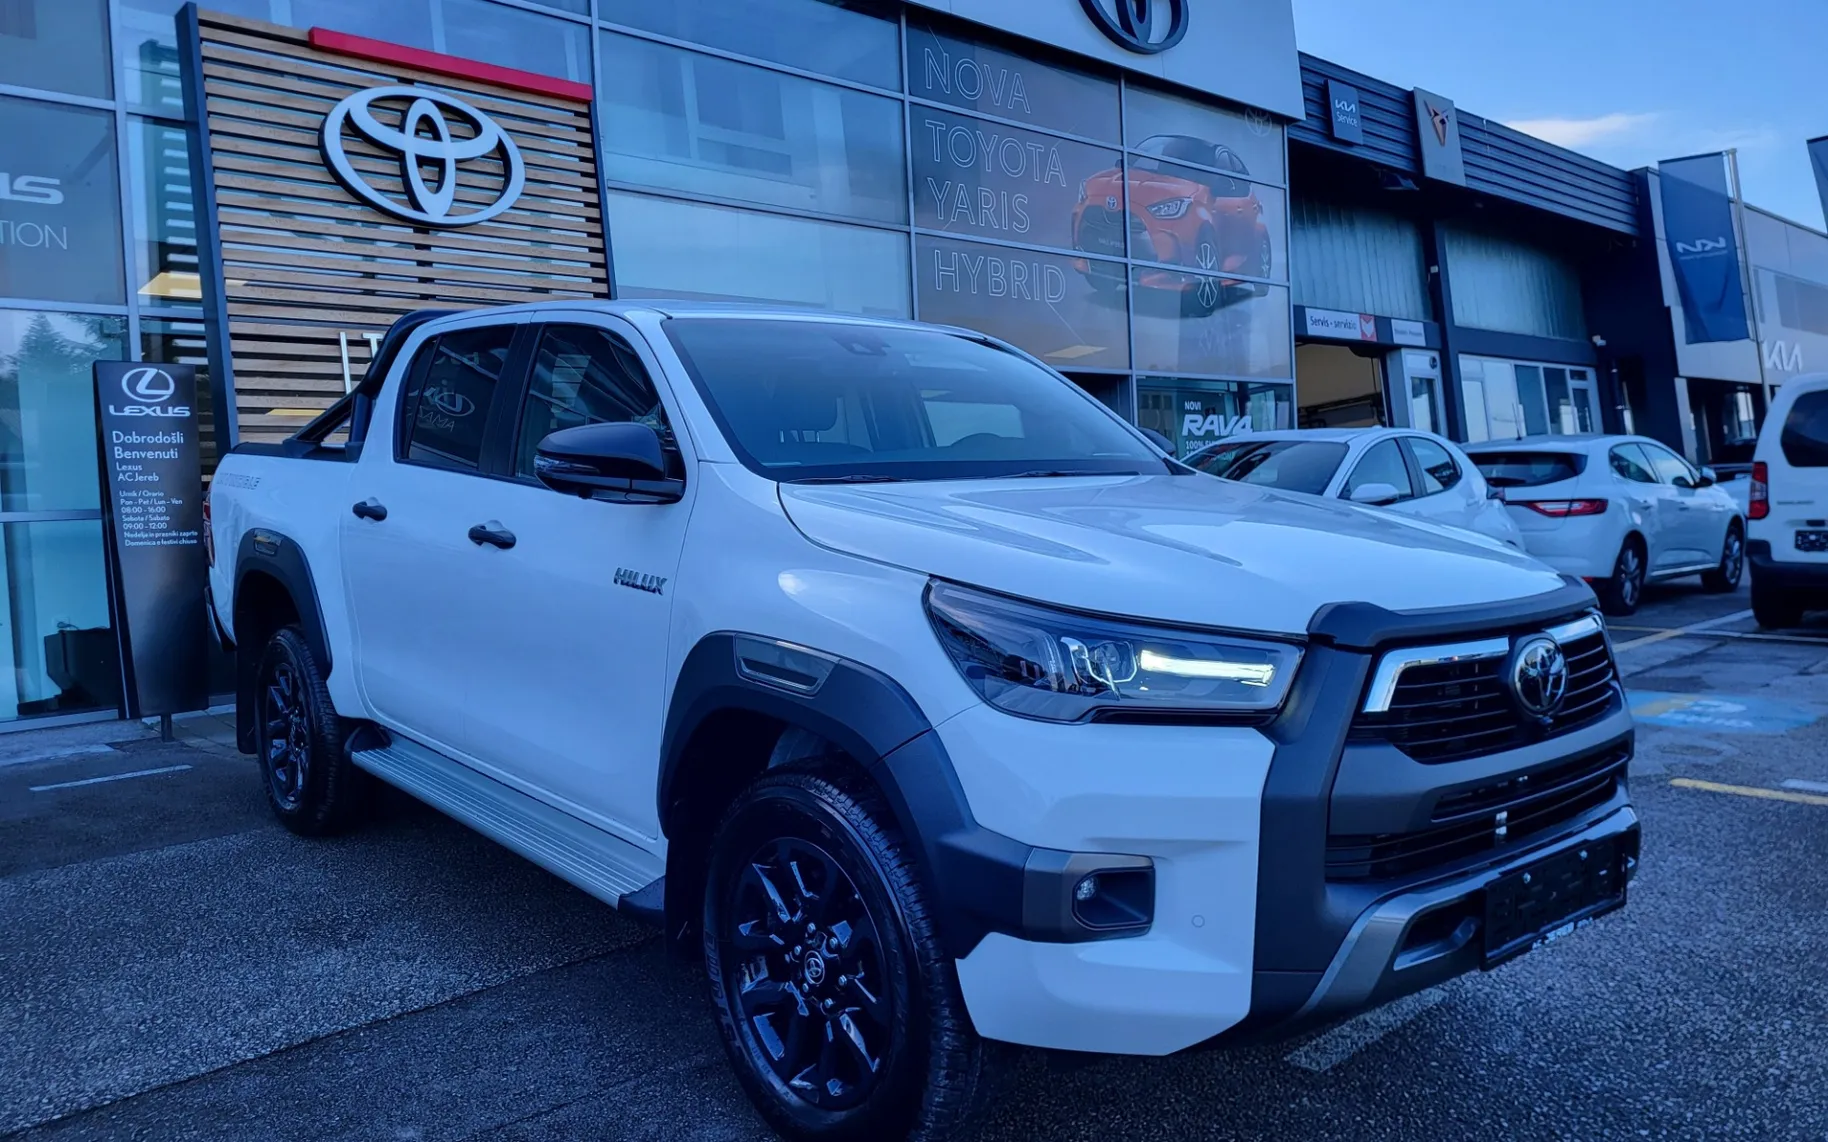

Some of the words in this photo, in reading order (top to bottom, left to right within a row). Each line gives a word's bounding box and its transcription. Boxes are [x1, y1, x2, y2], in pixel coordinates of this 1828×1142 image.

[924, 47, 1031, 114] NOVA
[1335, 99, 1356, 113] KIA
[1336, 111, 1358, 127] Service
[924, 119, 1066, 187] TOYOTA
[927, 177, 1030, 234] YARIS
[934, 249, 1066, 303] HYBRID
[1310, 316, 1329, 327] Servis
[109, 404, 191, 417] LEXUS
[1184, 401, 1201, 411] NOVI
[1182, 414, 1253, 436] RAV4
[112, 431, 184, 444] Dobrodošli
[114, 447, 178, 459] Benvenuti
[116, 462, 143, 471] Lexus
[118, 473, 134, 482] AC
[134, 473, 159, 482] Jereb
[613, 567, 668, 596] HILUX
